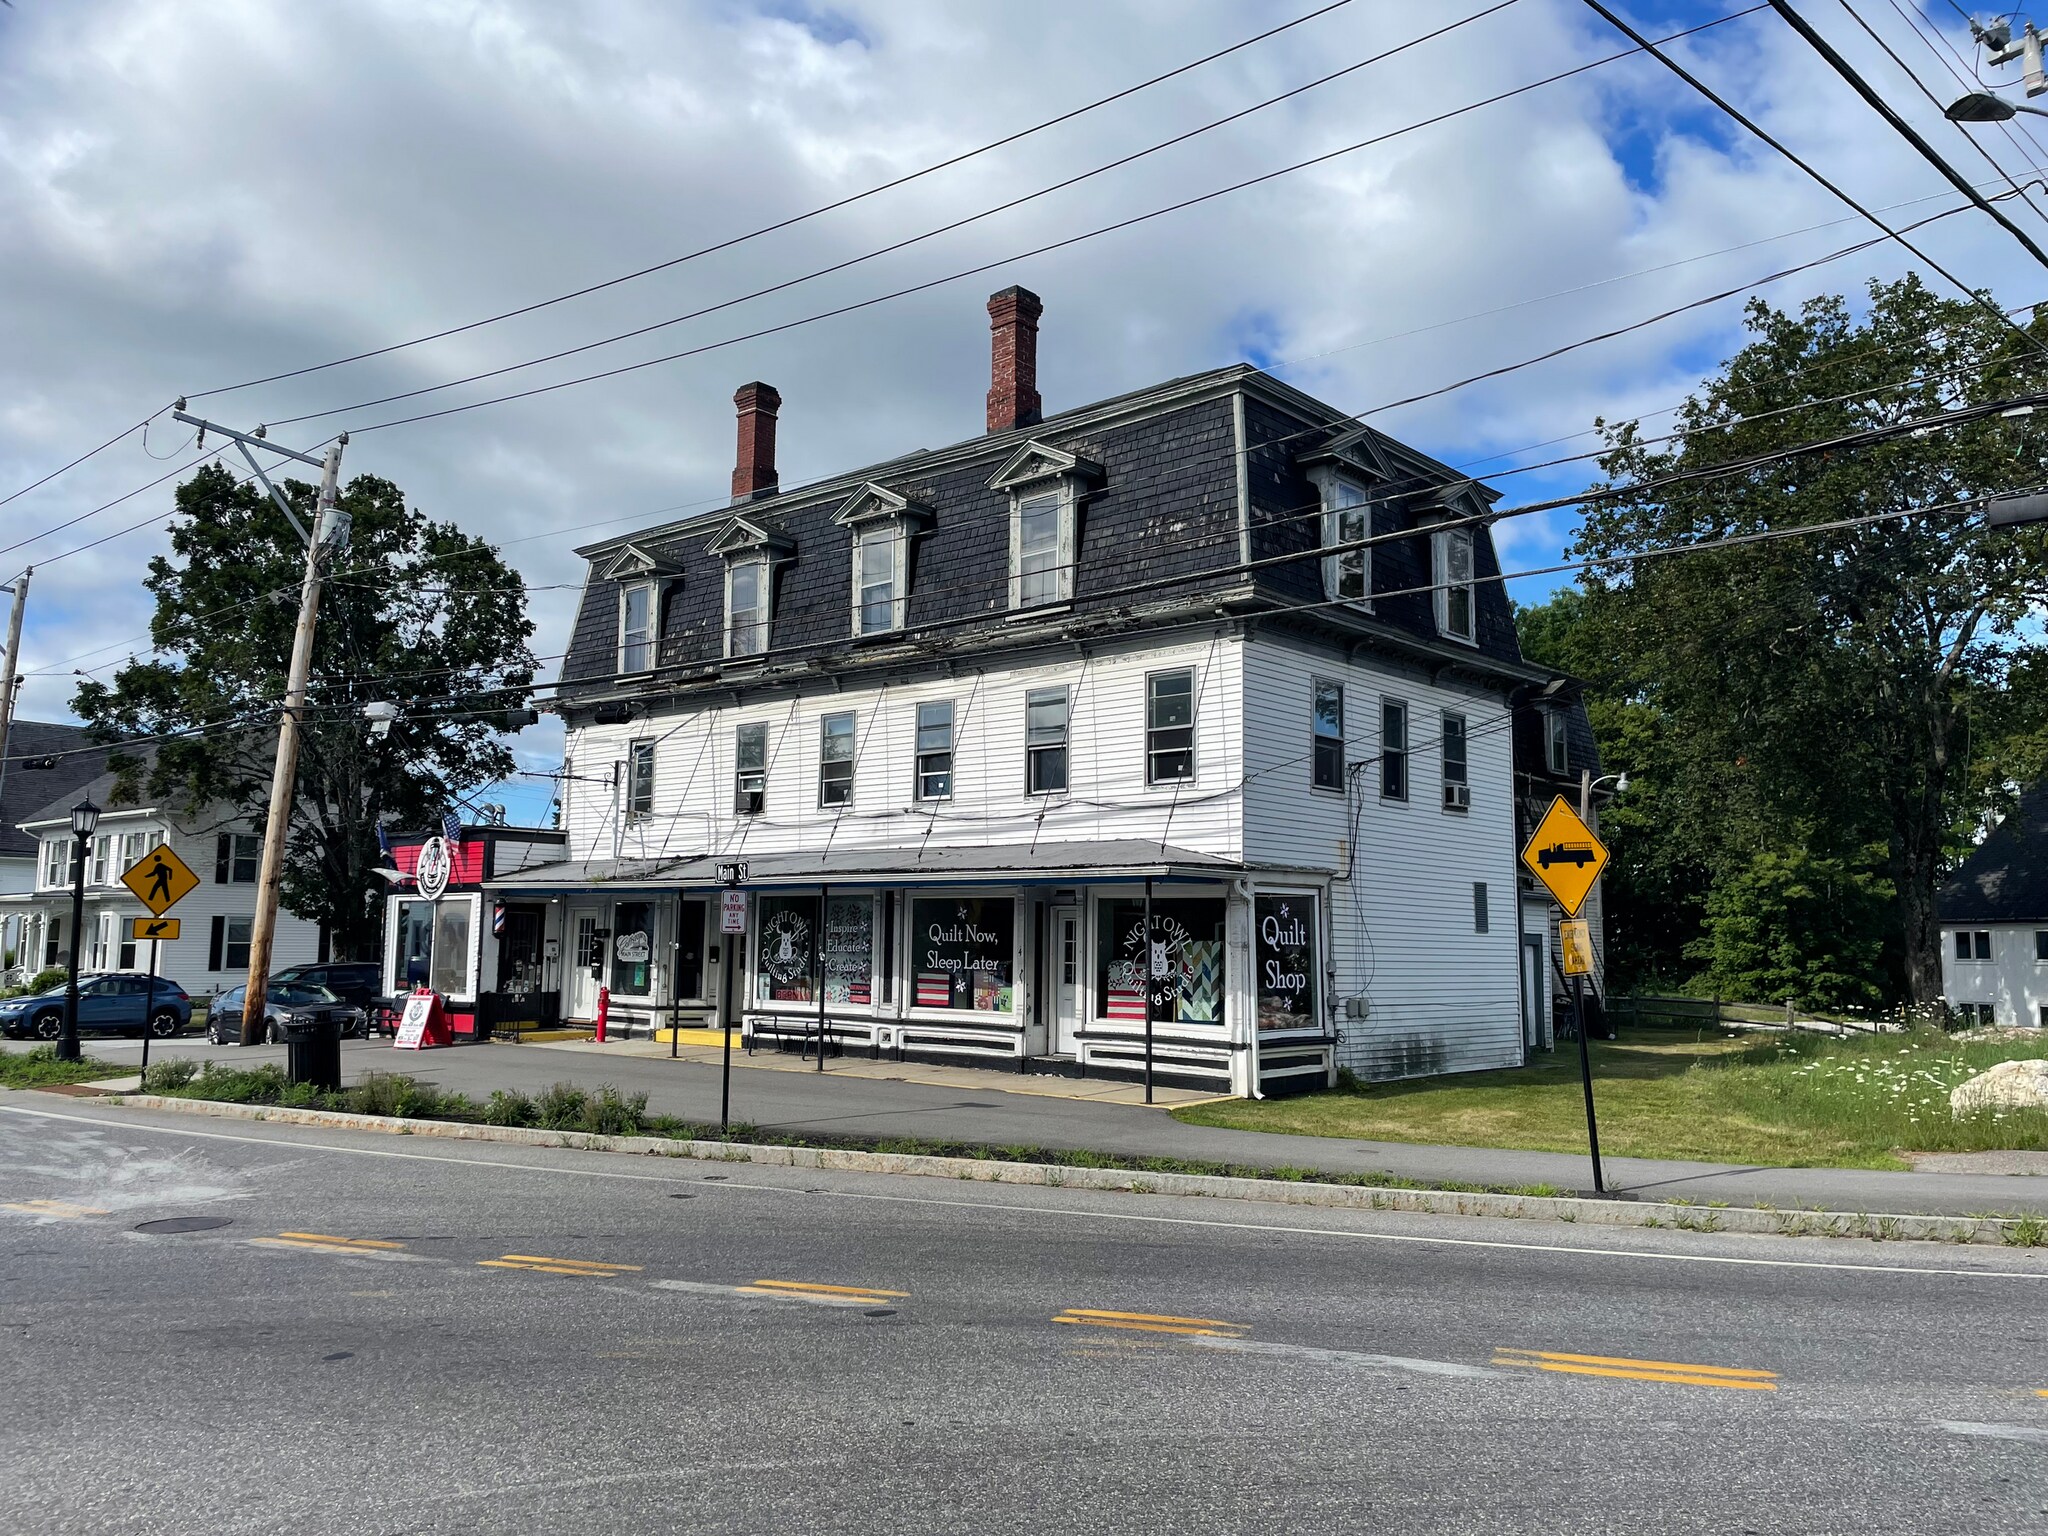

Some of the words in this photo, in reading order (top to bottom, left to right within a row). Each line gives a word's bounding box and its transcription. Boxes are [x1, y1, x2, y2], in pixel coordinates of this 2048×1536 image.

[717, 864, 735, 881] Main
[738, 863, 747, 880] St
[723, 903, 745, 912] PARKING
[729, 894, 740, 903] NO
[829, 920, 858, 935] Inspire
[928, 923, 963, 946] Quilt
[964, 924, 999, 946] Now,
[1262, 915, 1307, 952] Quilt
[827, 939, 861, 952] Educate
[761, 947, 788, 984] Quilting
[788, 950, 809, 980] Studio
[828, 958, 858, 972] Create
[926, 950, 962, 973] Sleep
[963, 950, 999, 971] Later
[1163, 965, 1195, 1001] Studio
[1265, 959, 1306, 995] Shop
